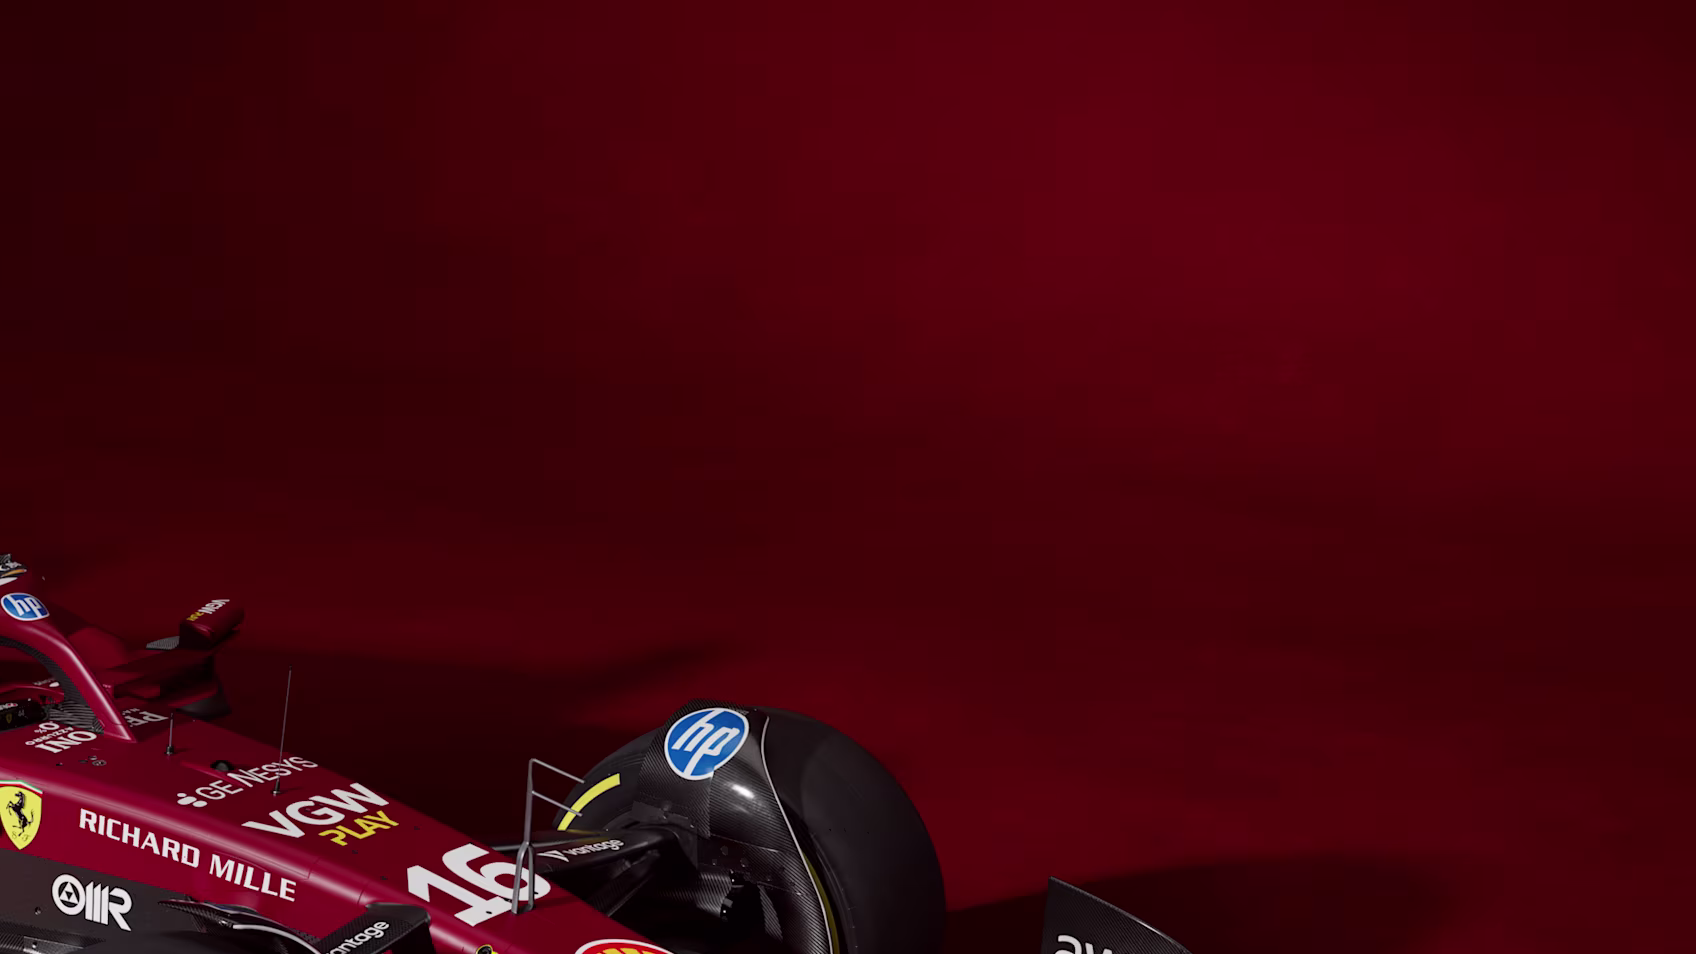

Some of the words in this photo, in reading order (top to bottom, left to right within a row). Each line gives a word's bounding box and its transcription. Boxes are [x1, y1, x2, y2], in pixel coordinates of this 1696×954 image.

[3, 594, 46, 619] hp
[668, 707, 744, 779] hp
[241, 782, 390, 839] VGW
[318, 810, 399, 846] PLAY
[79, 807, 201, 869] RICHARD
[209, 853, 296, 902] MILLE
[407, 843, 551, 927] 16
